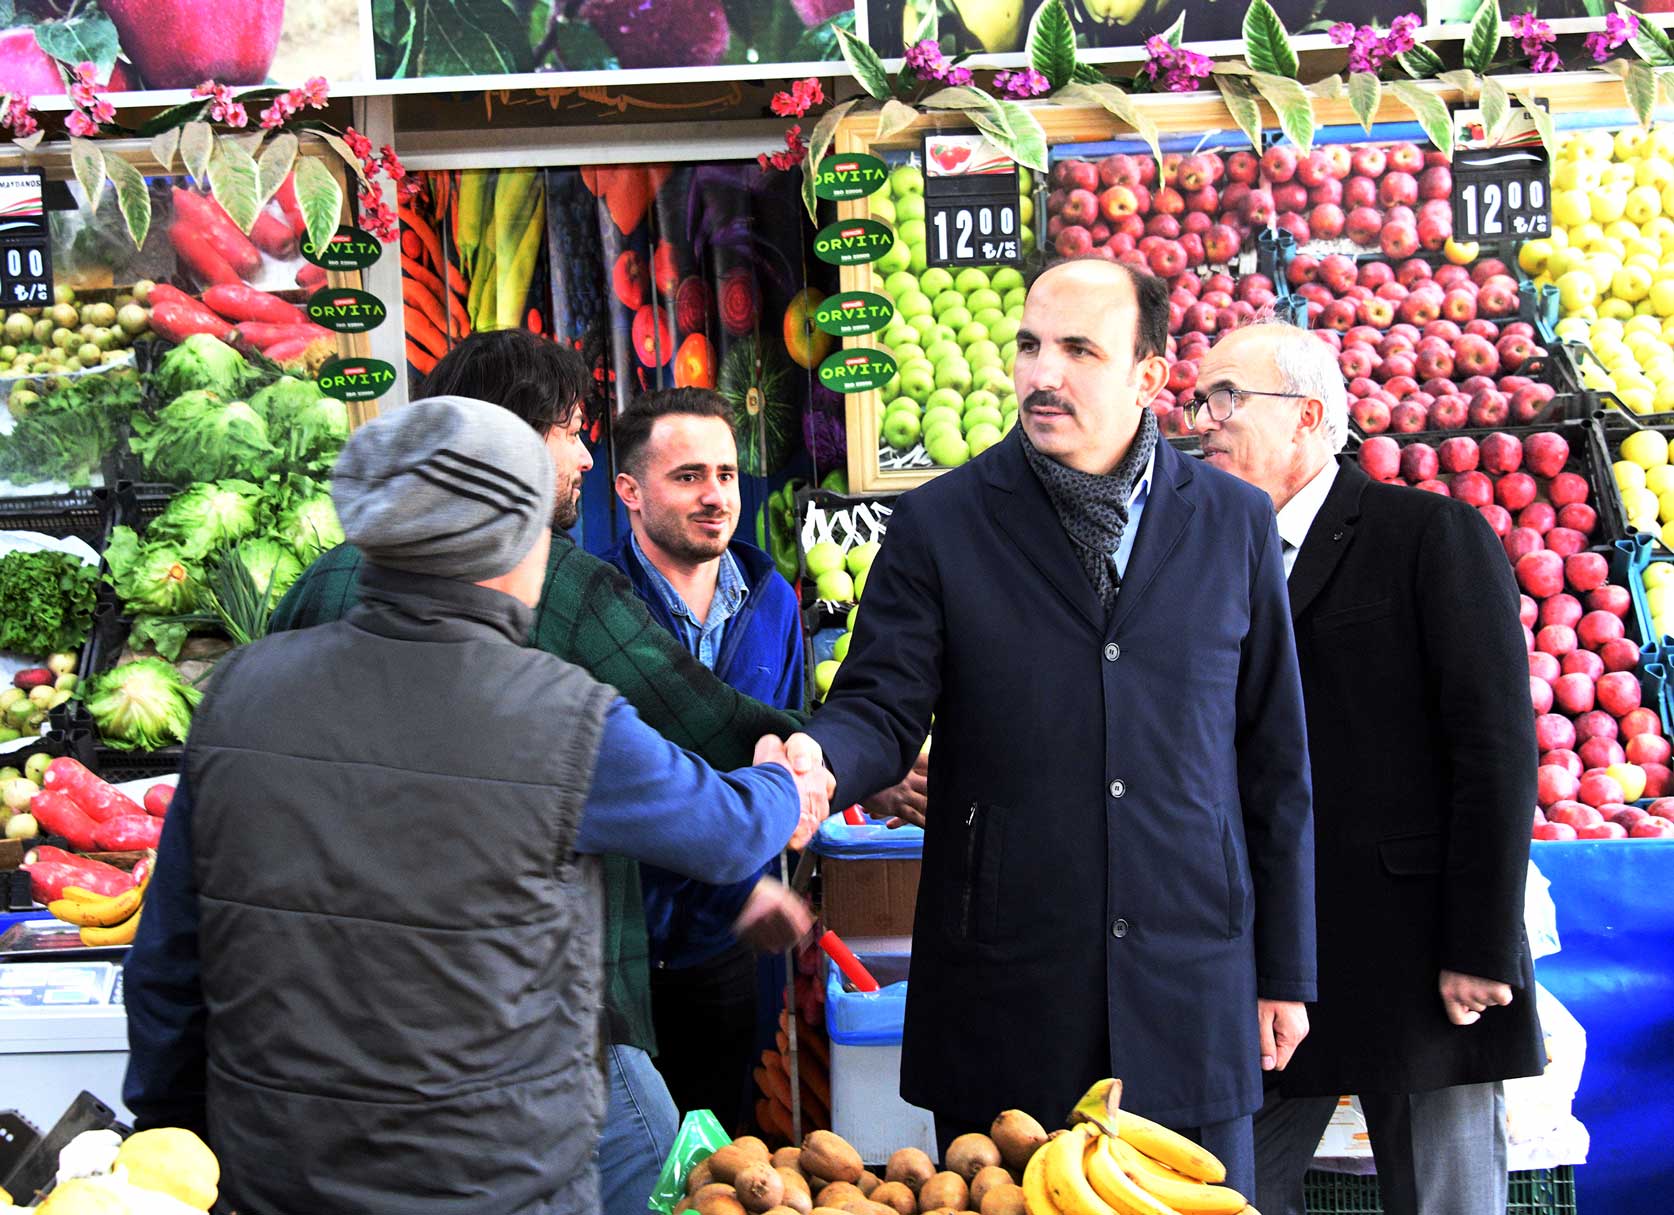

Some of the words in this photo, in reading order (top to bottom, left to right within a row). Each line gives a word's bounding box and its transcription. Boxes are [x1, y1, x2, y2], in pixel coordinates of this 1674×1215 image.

[814, 168, 885, 186] ORVITA
[303, 242, 379, 255] OVITA
[816, 234, 891, 252] ORVITA
[310, 304, 384, 317] ORVITA
[817, 306, 891, 323] ORVITA
[320, 369, 394, 389] ORVITA
[821, 362, 894, 379] ORVITA
